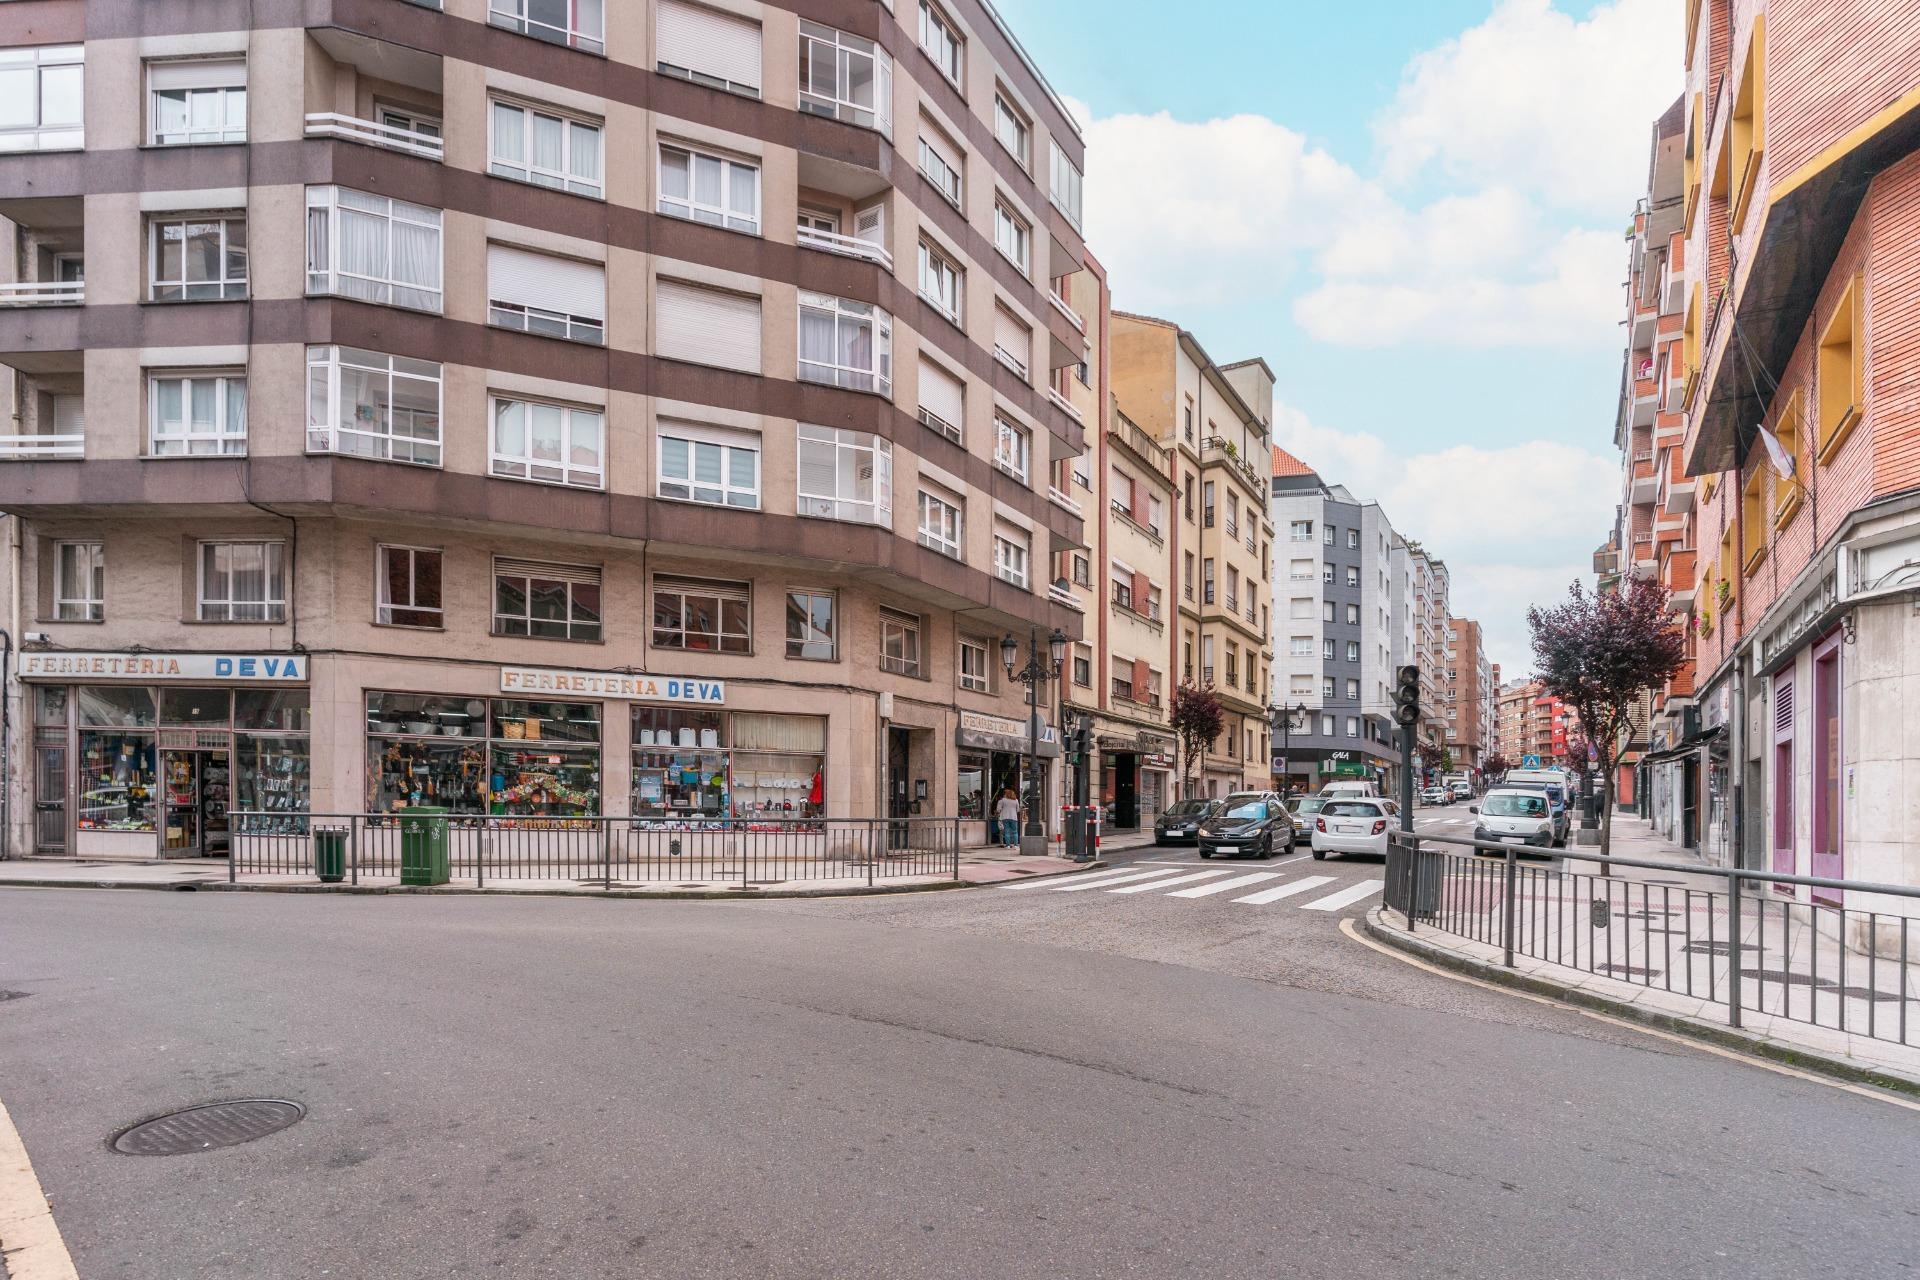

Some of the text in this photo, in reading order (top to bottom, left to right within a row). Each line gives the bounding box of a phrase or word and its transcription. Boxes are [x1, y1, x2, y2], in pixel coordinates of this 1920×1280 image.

[26, 656, 299, 677] FERRETERIA DEVA
[504, 671, 723, 701] FERRETERIA DEVA
[1332, 752, 1349, 760] GALA
